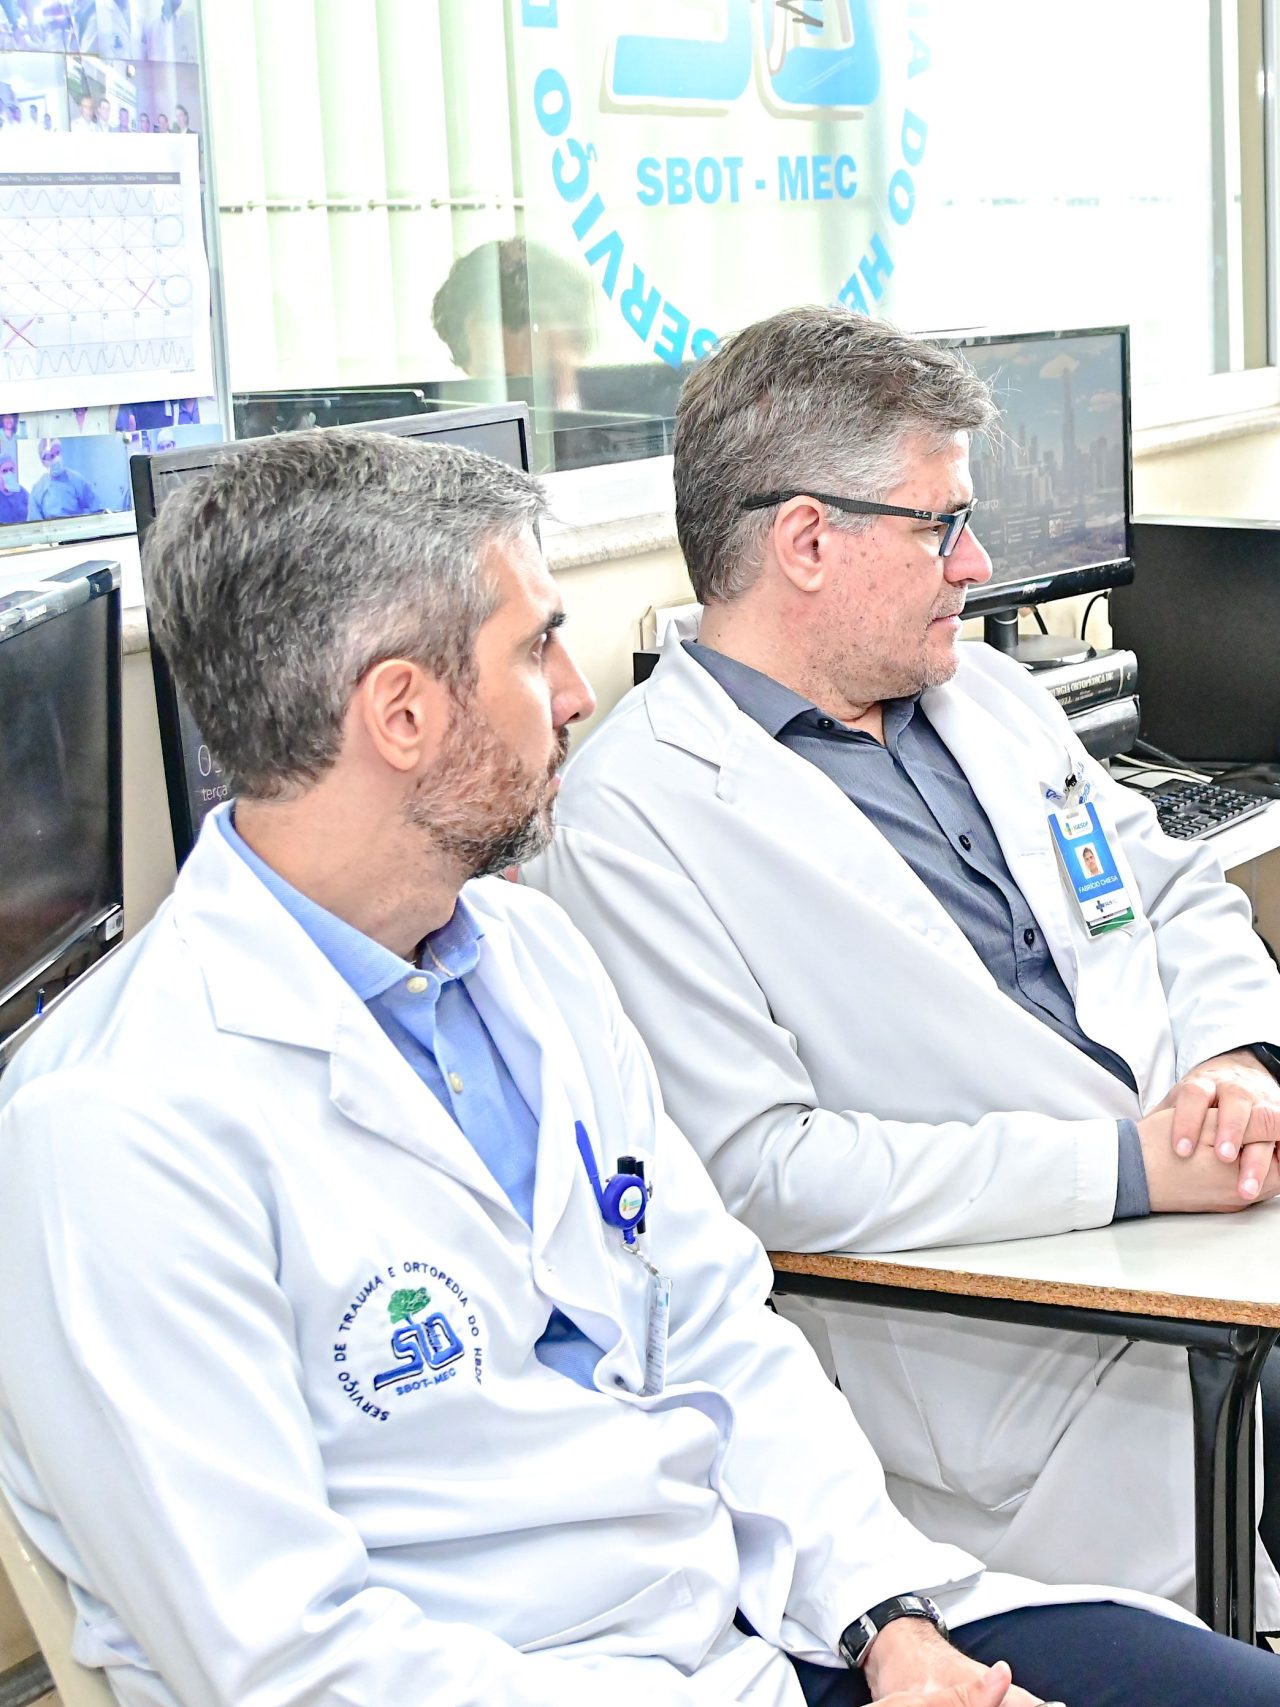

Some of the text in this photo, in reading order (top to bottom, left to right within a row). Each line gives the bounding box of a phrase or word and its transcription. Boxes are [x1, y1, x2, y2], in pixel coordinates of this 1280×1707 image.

[636, 156, 743, 206] SBOT
[778, 154, 858, 200] MEC
[387, 1267, 396, 1278] E
[403, 1261, 469, 1308] ORTOPEDIA
[339, 1275, 384, 1332] TRAUMA
[468, 1315, 480, 1337] DO
[334, 1343, 347, 1362] DE
